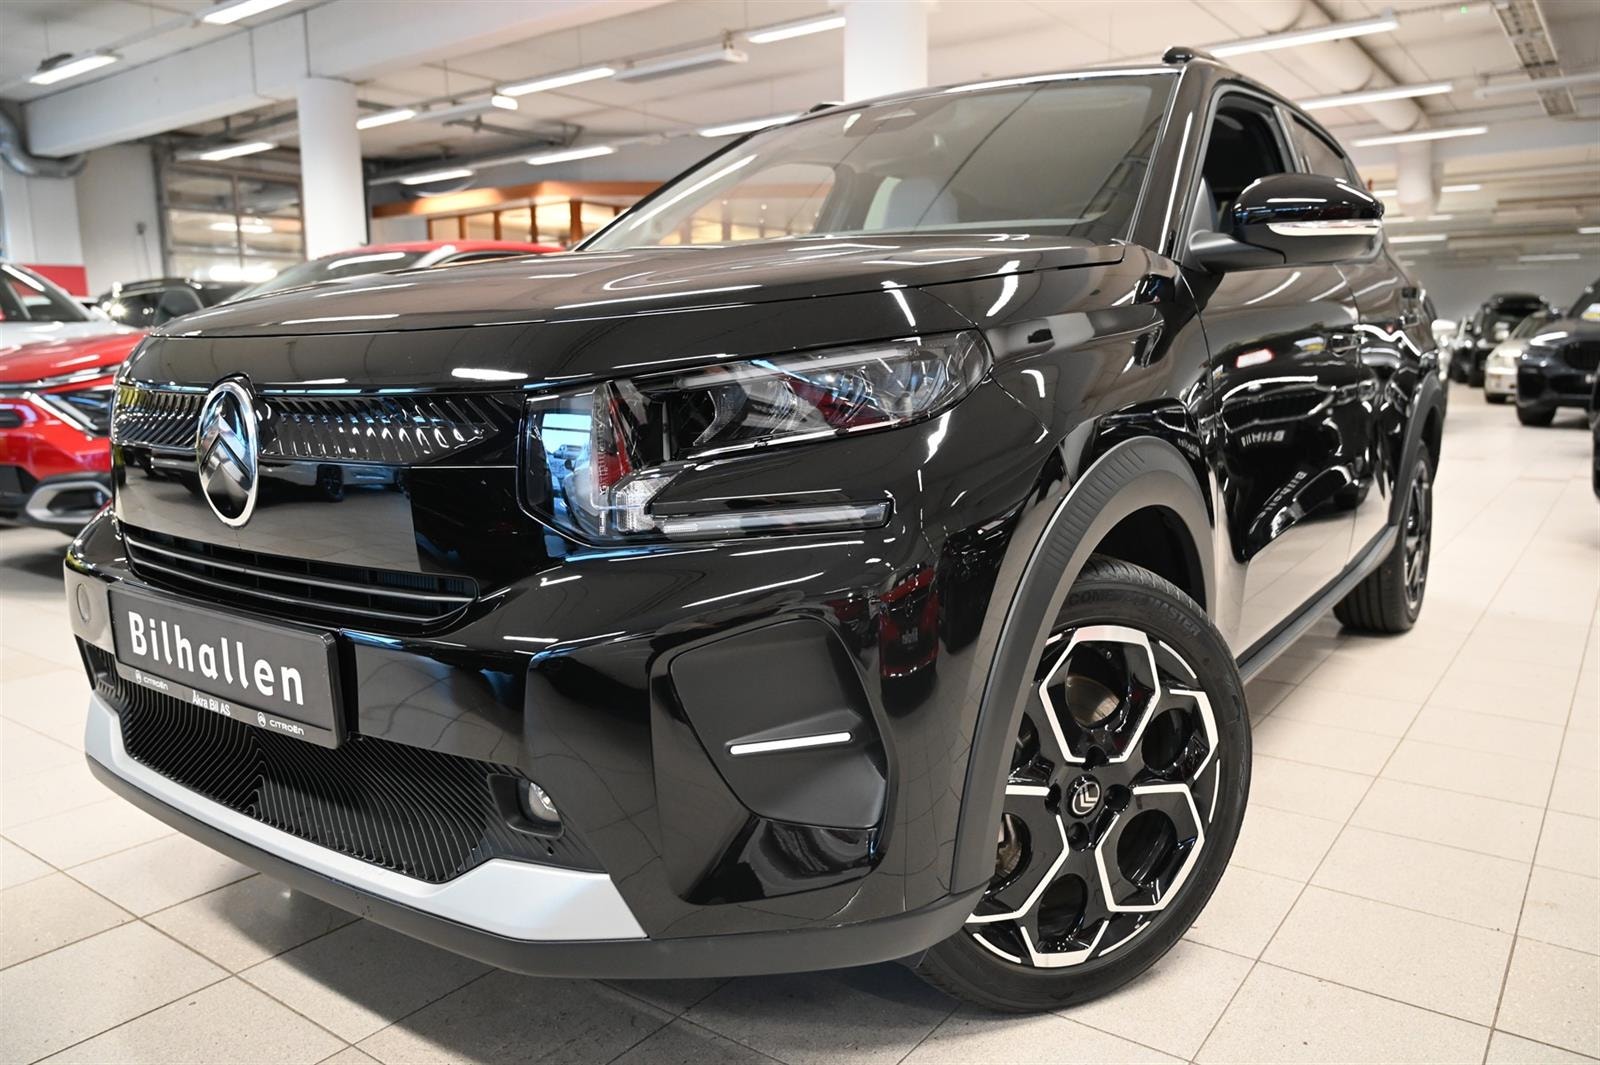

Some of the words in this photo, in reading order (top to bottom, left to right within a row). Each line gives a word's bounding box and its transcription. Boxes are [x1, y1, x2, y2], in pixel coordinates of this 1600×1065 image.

[128, 610, 304, 706] Bilhallen
[209, 699, 220, 712] Bil
[220, 704, 231, 717] AS
[269, 718, 305, 736] CITROËN
